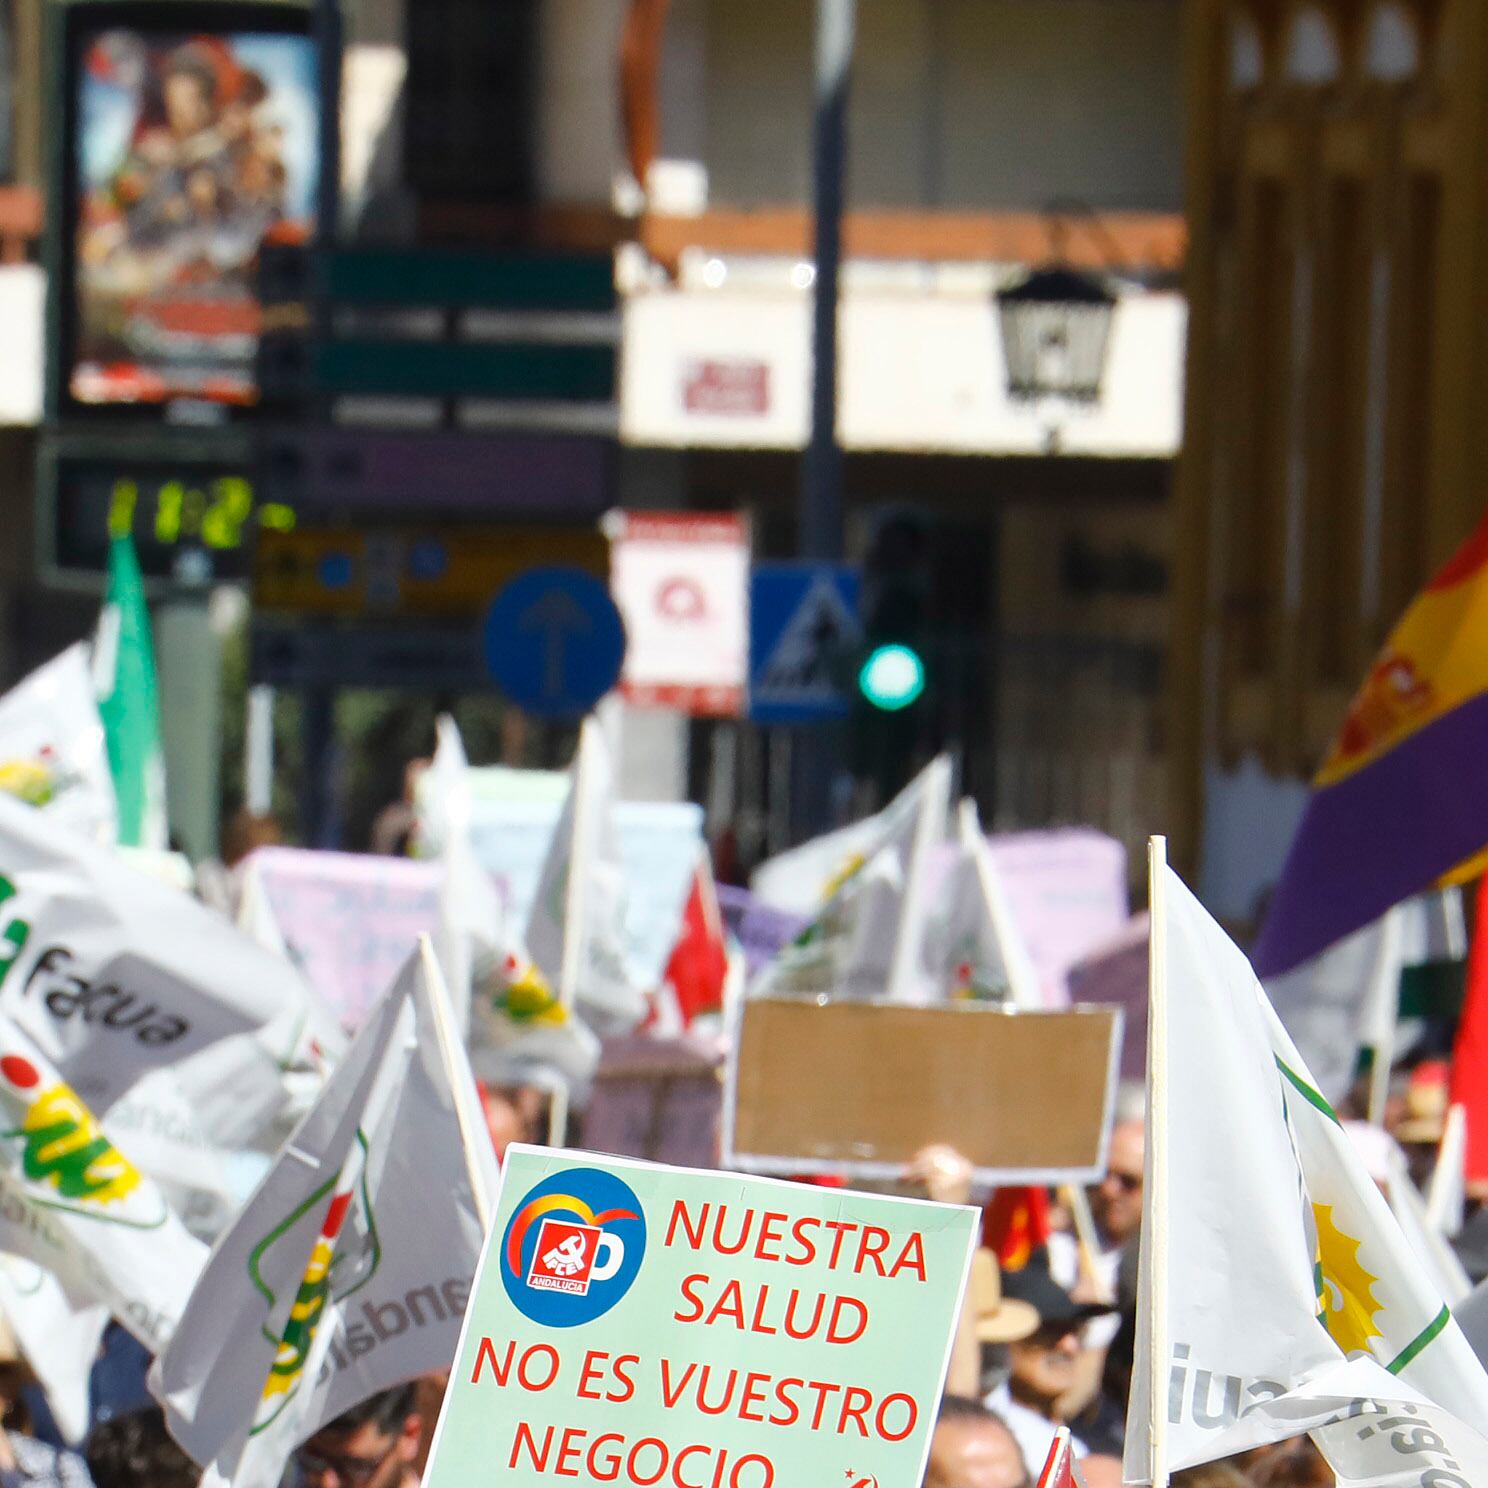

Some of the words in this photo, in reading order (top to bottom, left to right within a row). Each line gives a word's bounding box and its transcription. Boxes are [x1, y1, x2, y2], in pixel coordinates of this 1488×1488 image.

[664, 1199, 927, 1282] NUESTRA
[673, 1273, 869, 1345] SALUD
[470, 1336, 560, 1392] NO
[576, 1350, 641, 1403] ES
[661, 1358, 918, 1441] VUESTRO
